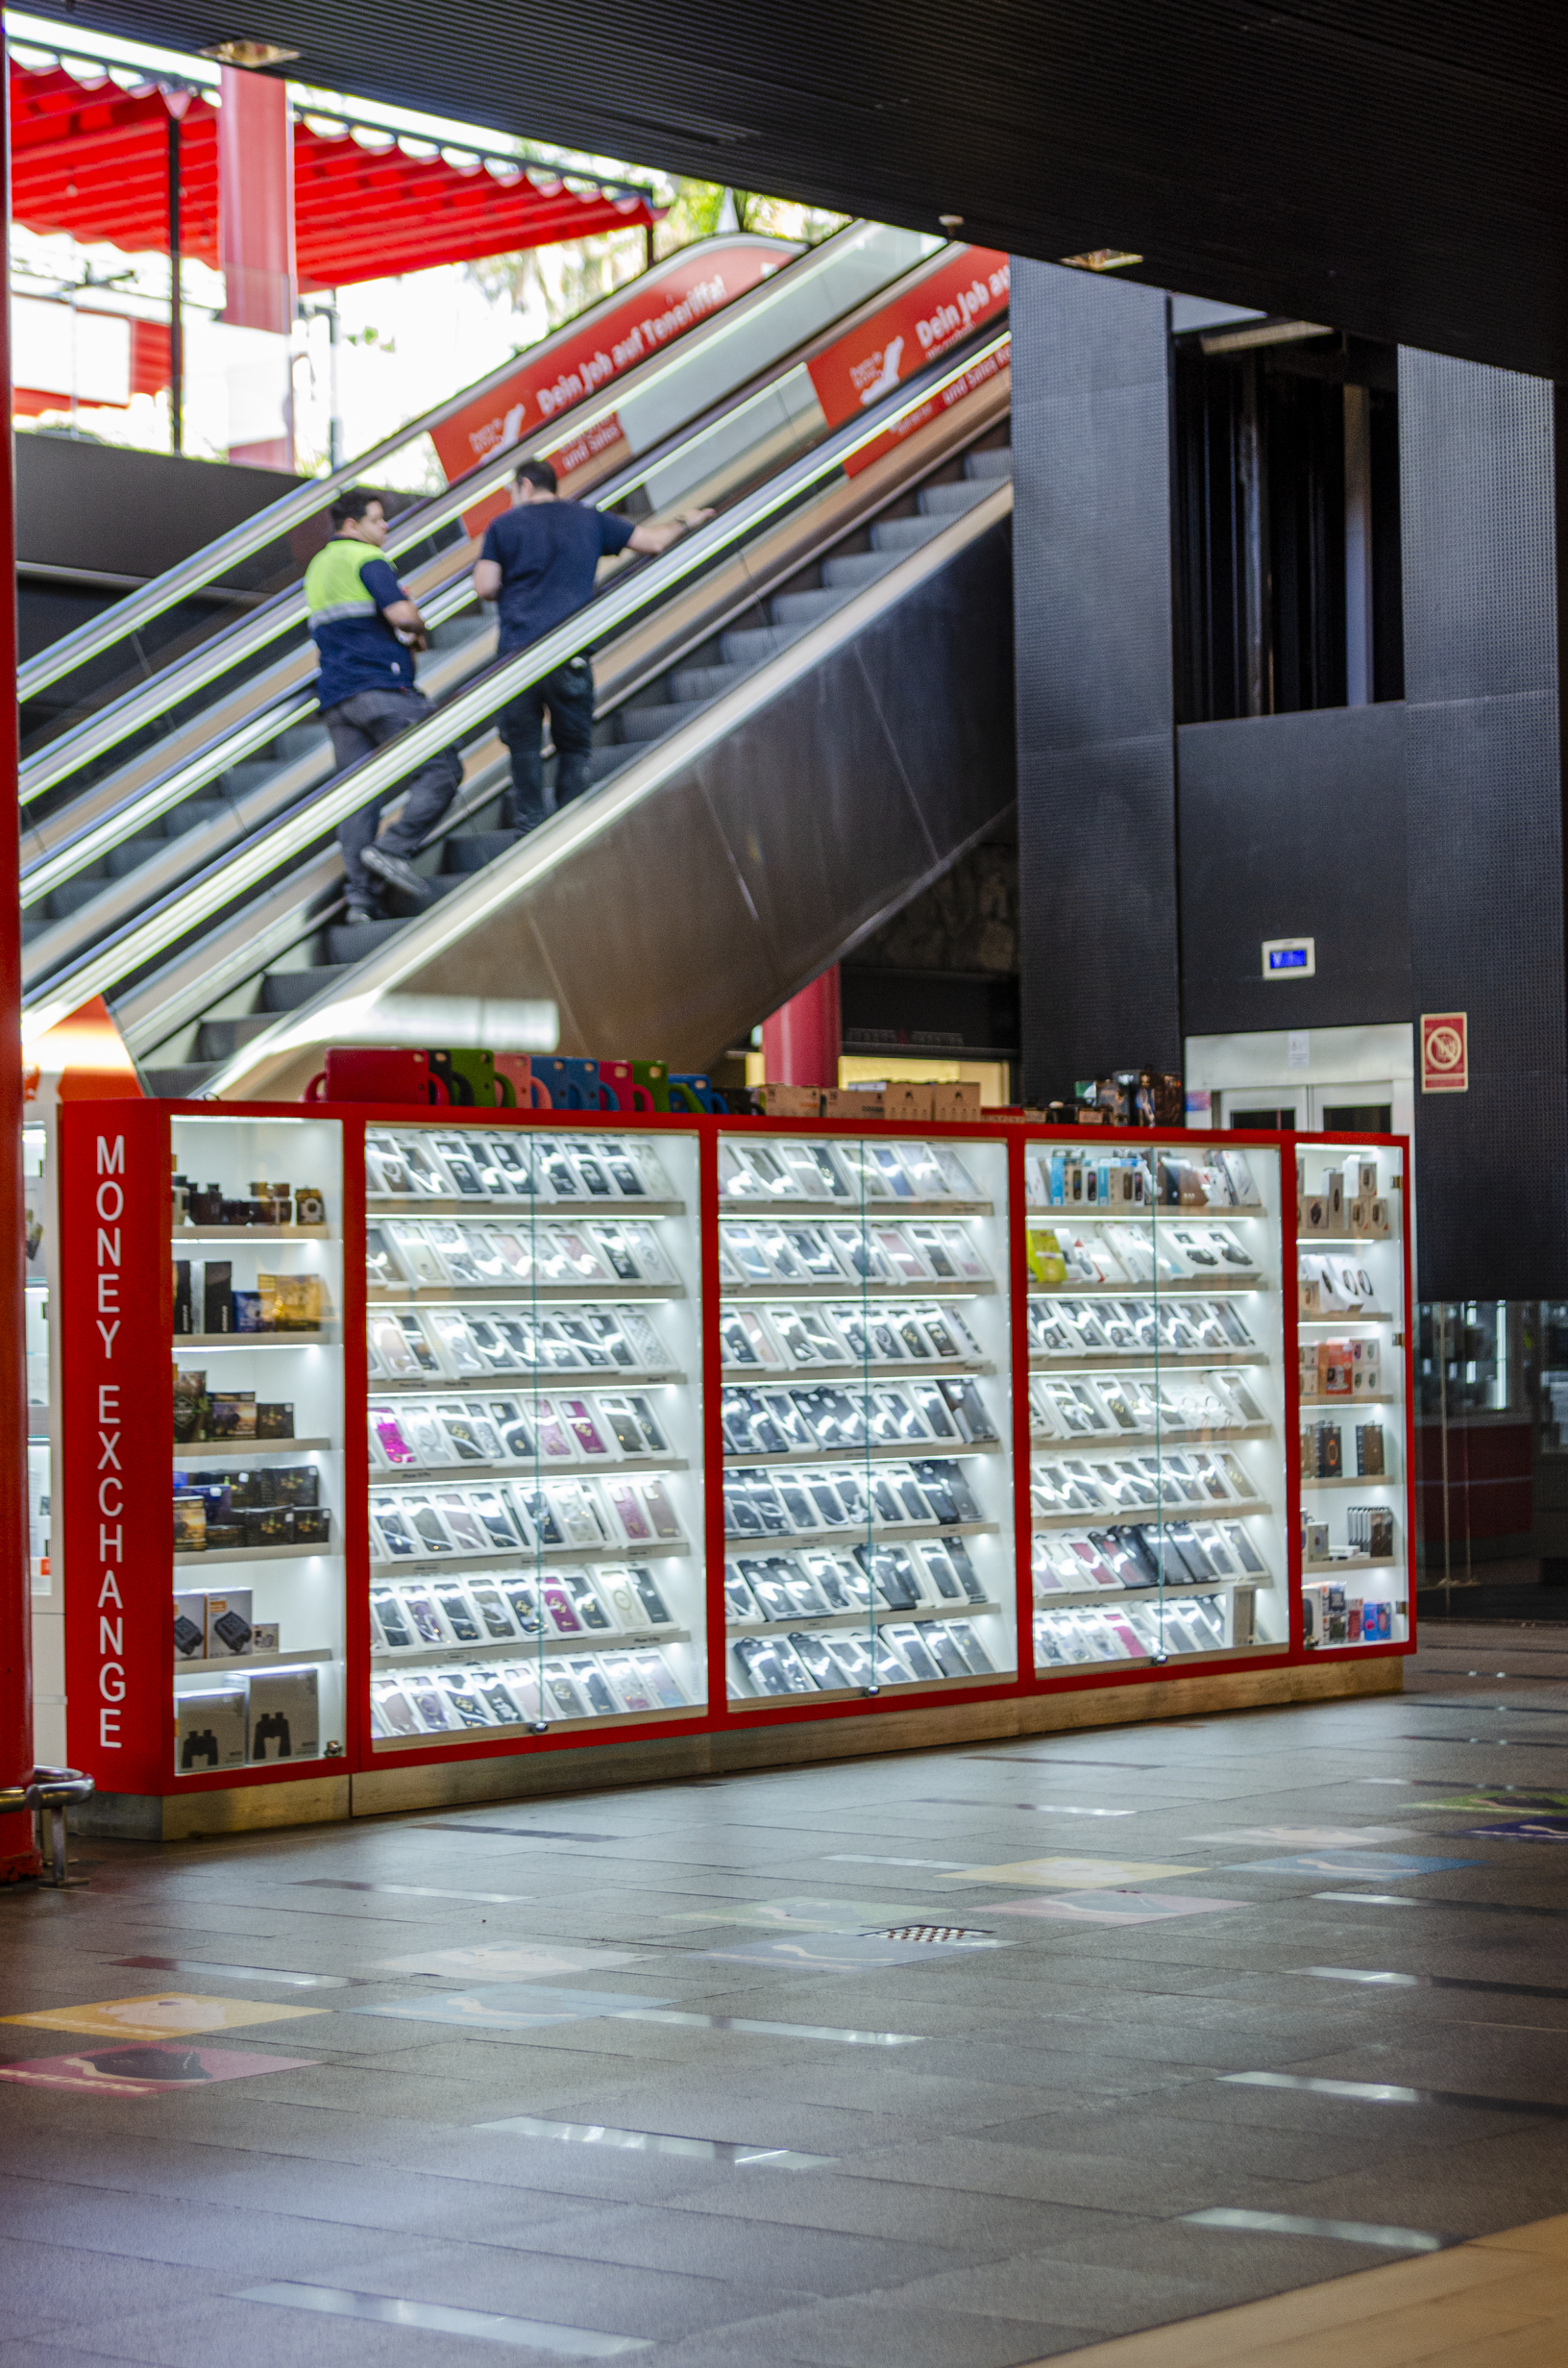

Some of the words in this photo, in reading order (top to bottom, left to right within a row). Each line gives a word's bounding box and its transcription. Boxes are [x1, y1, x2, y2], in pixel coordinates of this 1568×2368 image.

[536, 374, 583, 415] Dein
[578, 350, 613, 394] Job
[611, 326, 644, 367] auf
[640, 273, 727, 346] Teneriffa!
[915, 305, 961, 349] Dein
[957, 280, 990, 326] Job
[562, 437, 589, 470] und
[587, 423, 621, 453] Sales
[96, 1135, 126, 1359] MONEY
[98, 1385, 127, 1749] EXCHANGE
